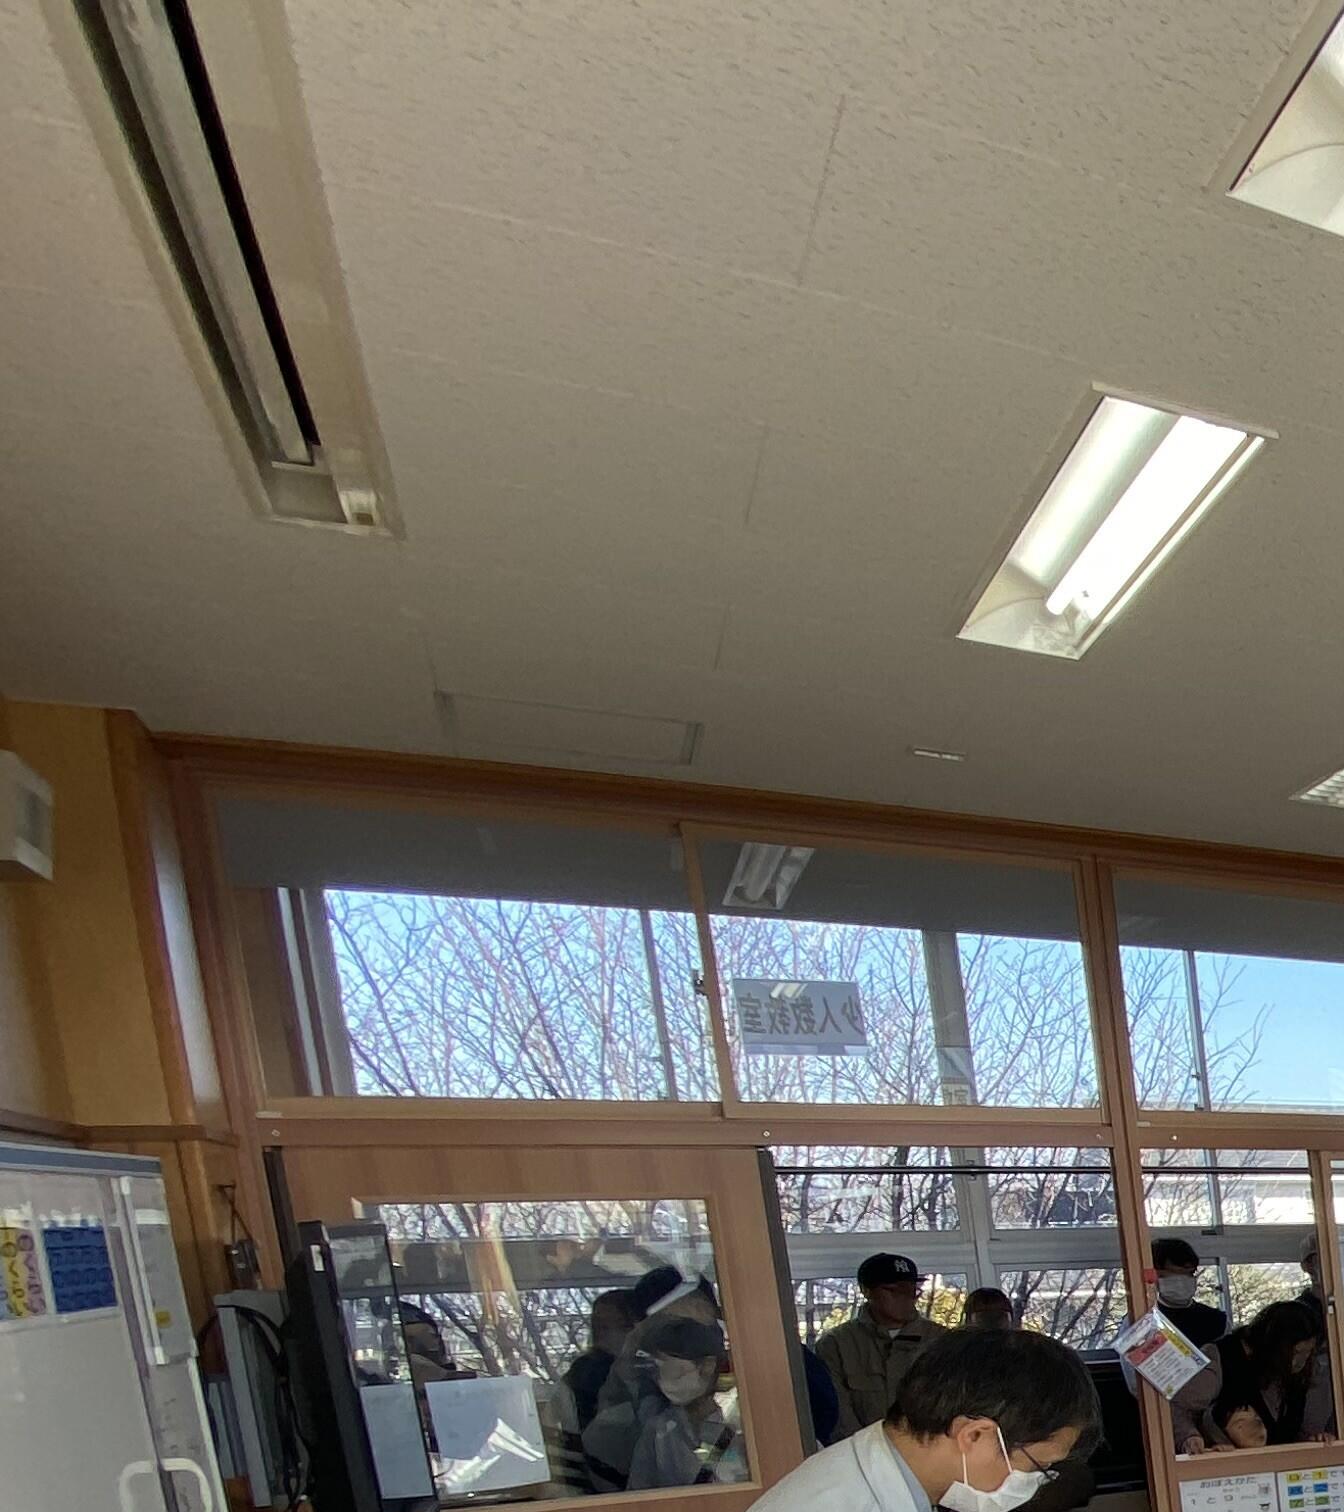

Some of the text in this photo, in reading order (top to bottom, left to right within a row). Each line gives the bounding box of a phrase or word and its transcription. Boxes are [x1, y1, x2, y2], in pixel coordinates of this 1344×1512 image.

[1200, 1476, 1257, 1489] おぼえかた
